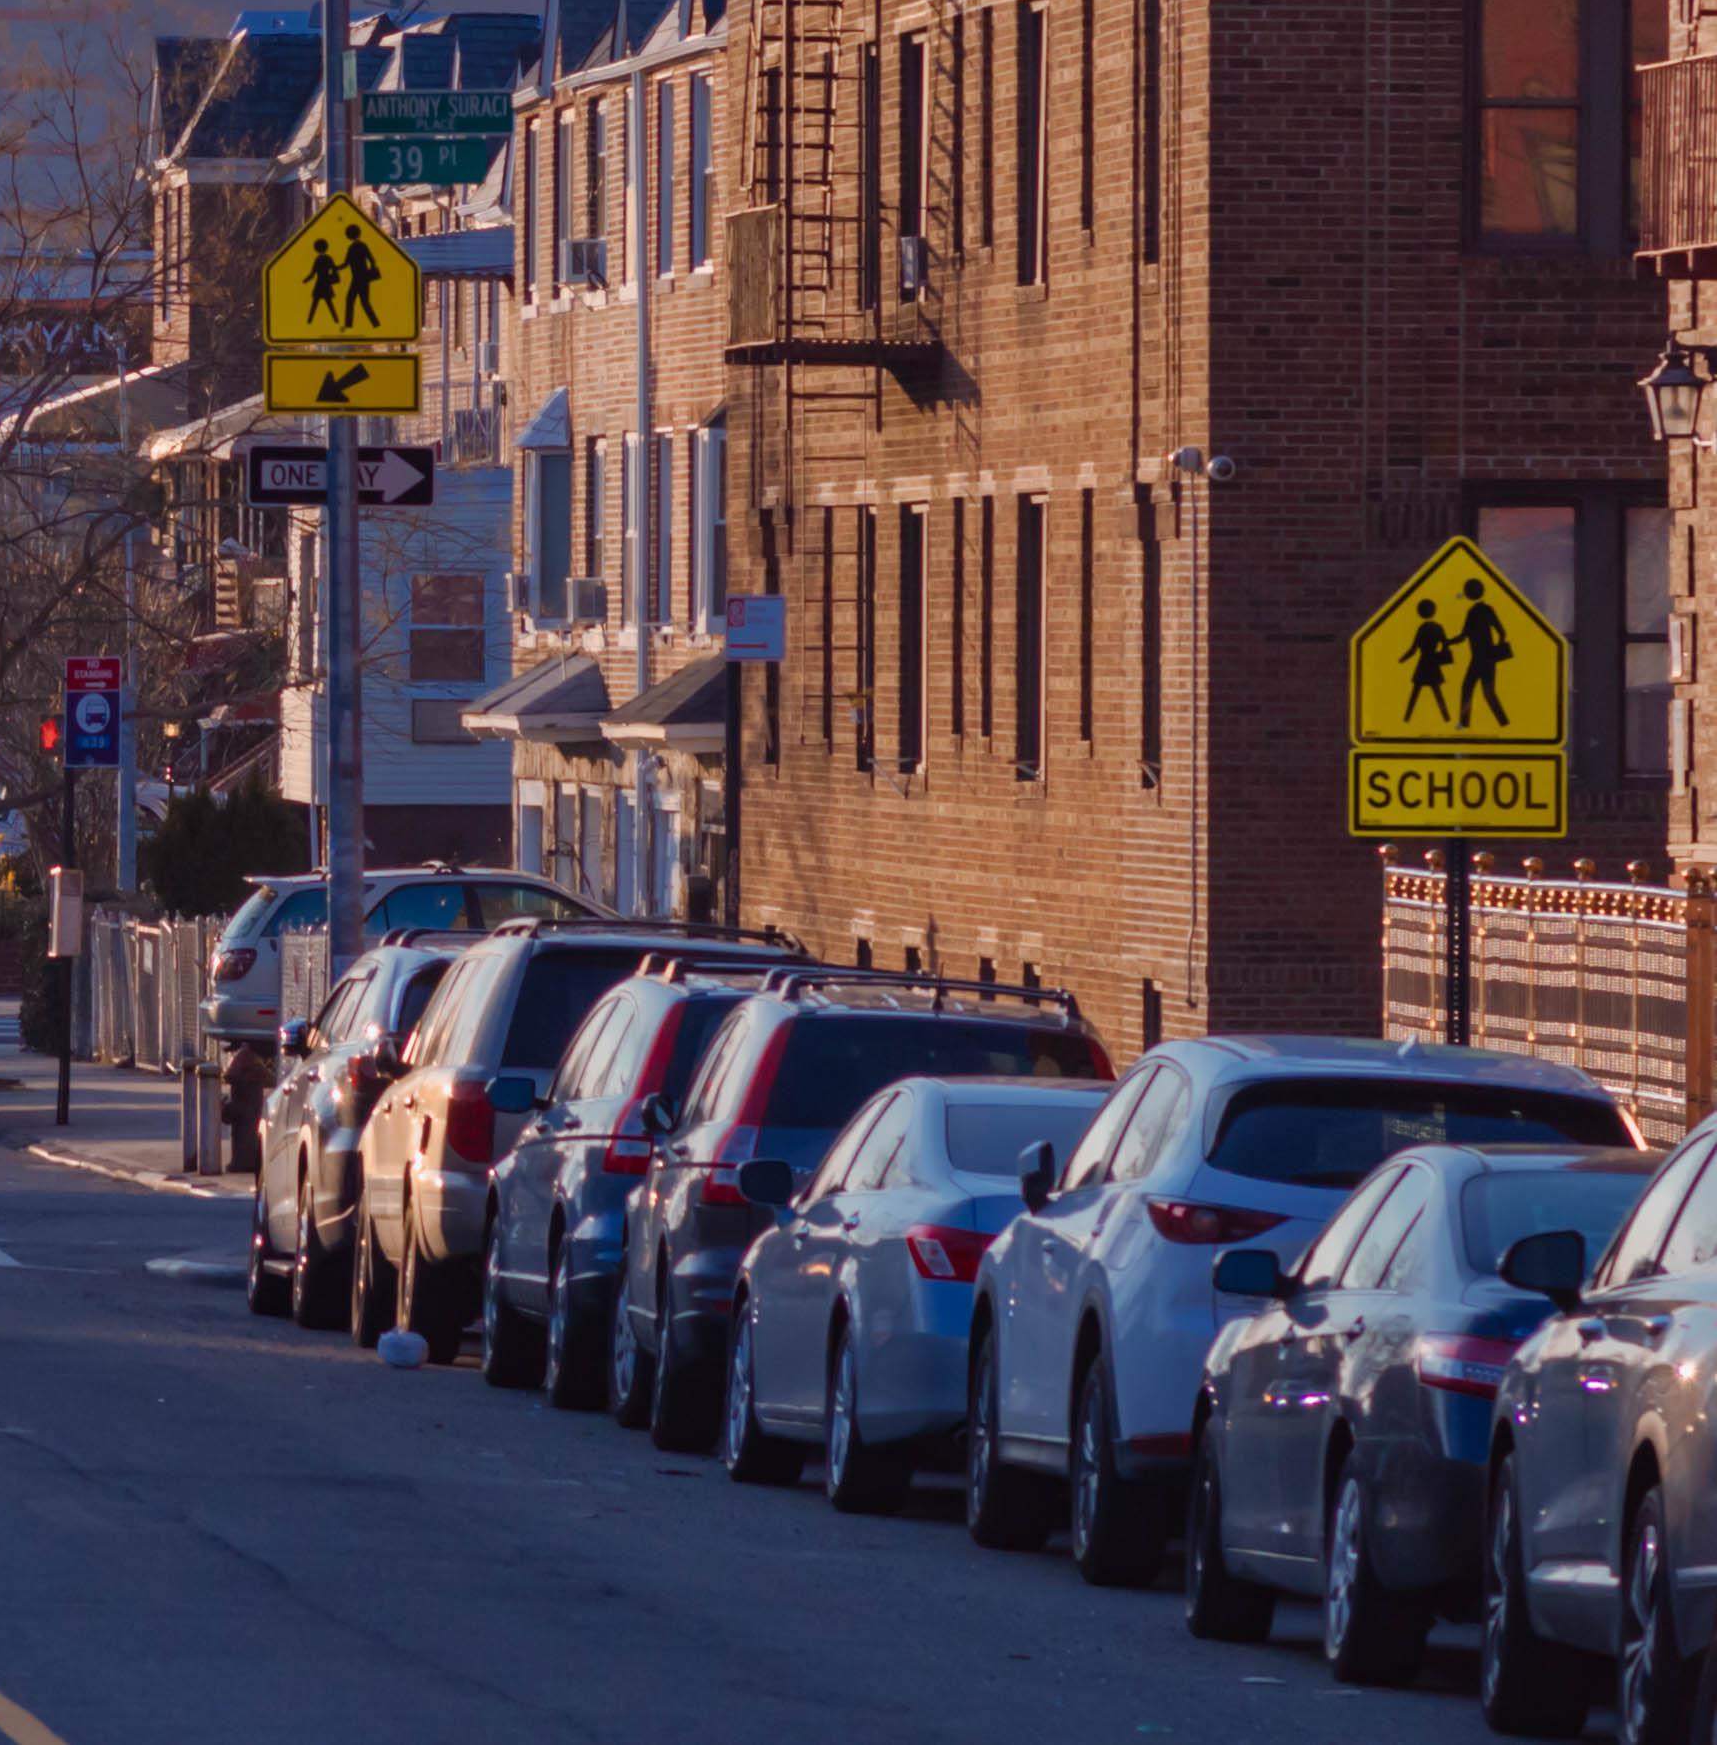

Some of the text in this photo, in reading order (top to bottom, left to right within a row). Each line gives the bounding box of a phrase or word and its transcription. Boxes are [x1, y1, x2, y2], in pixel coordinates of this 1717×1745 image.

[366, 94, 508, 118] ANTHONY SURACI
[416, 118, 456, 131] PLACE
[387, 145, 424, 180] 39
[270, 464, 319, 487] ONE
[86, 658, 100, 669] NO
[1367, 770, 1549, 810] SCHOOL
